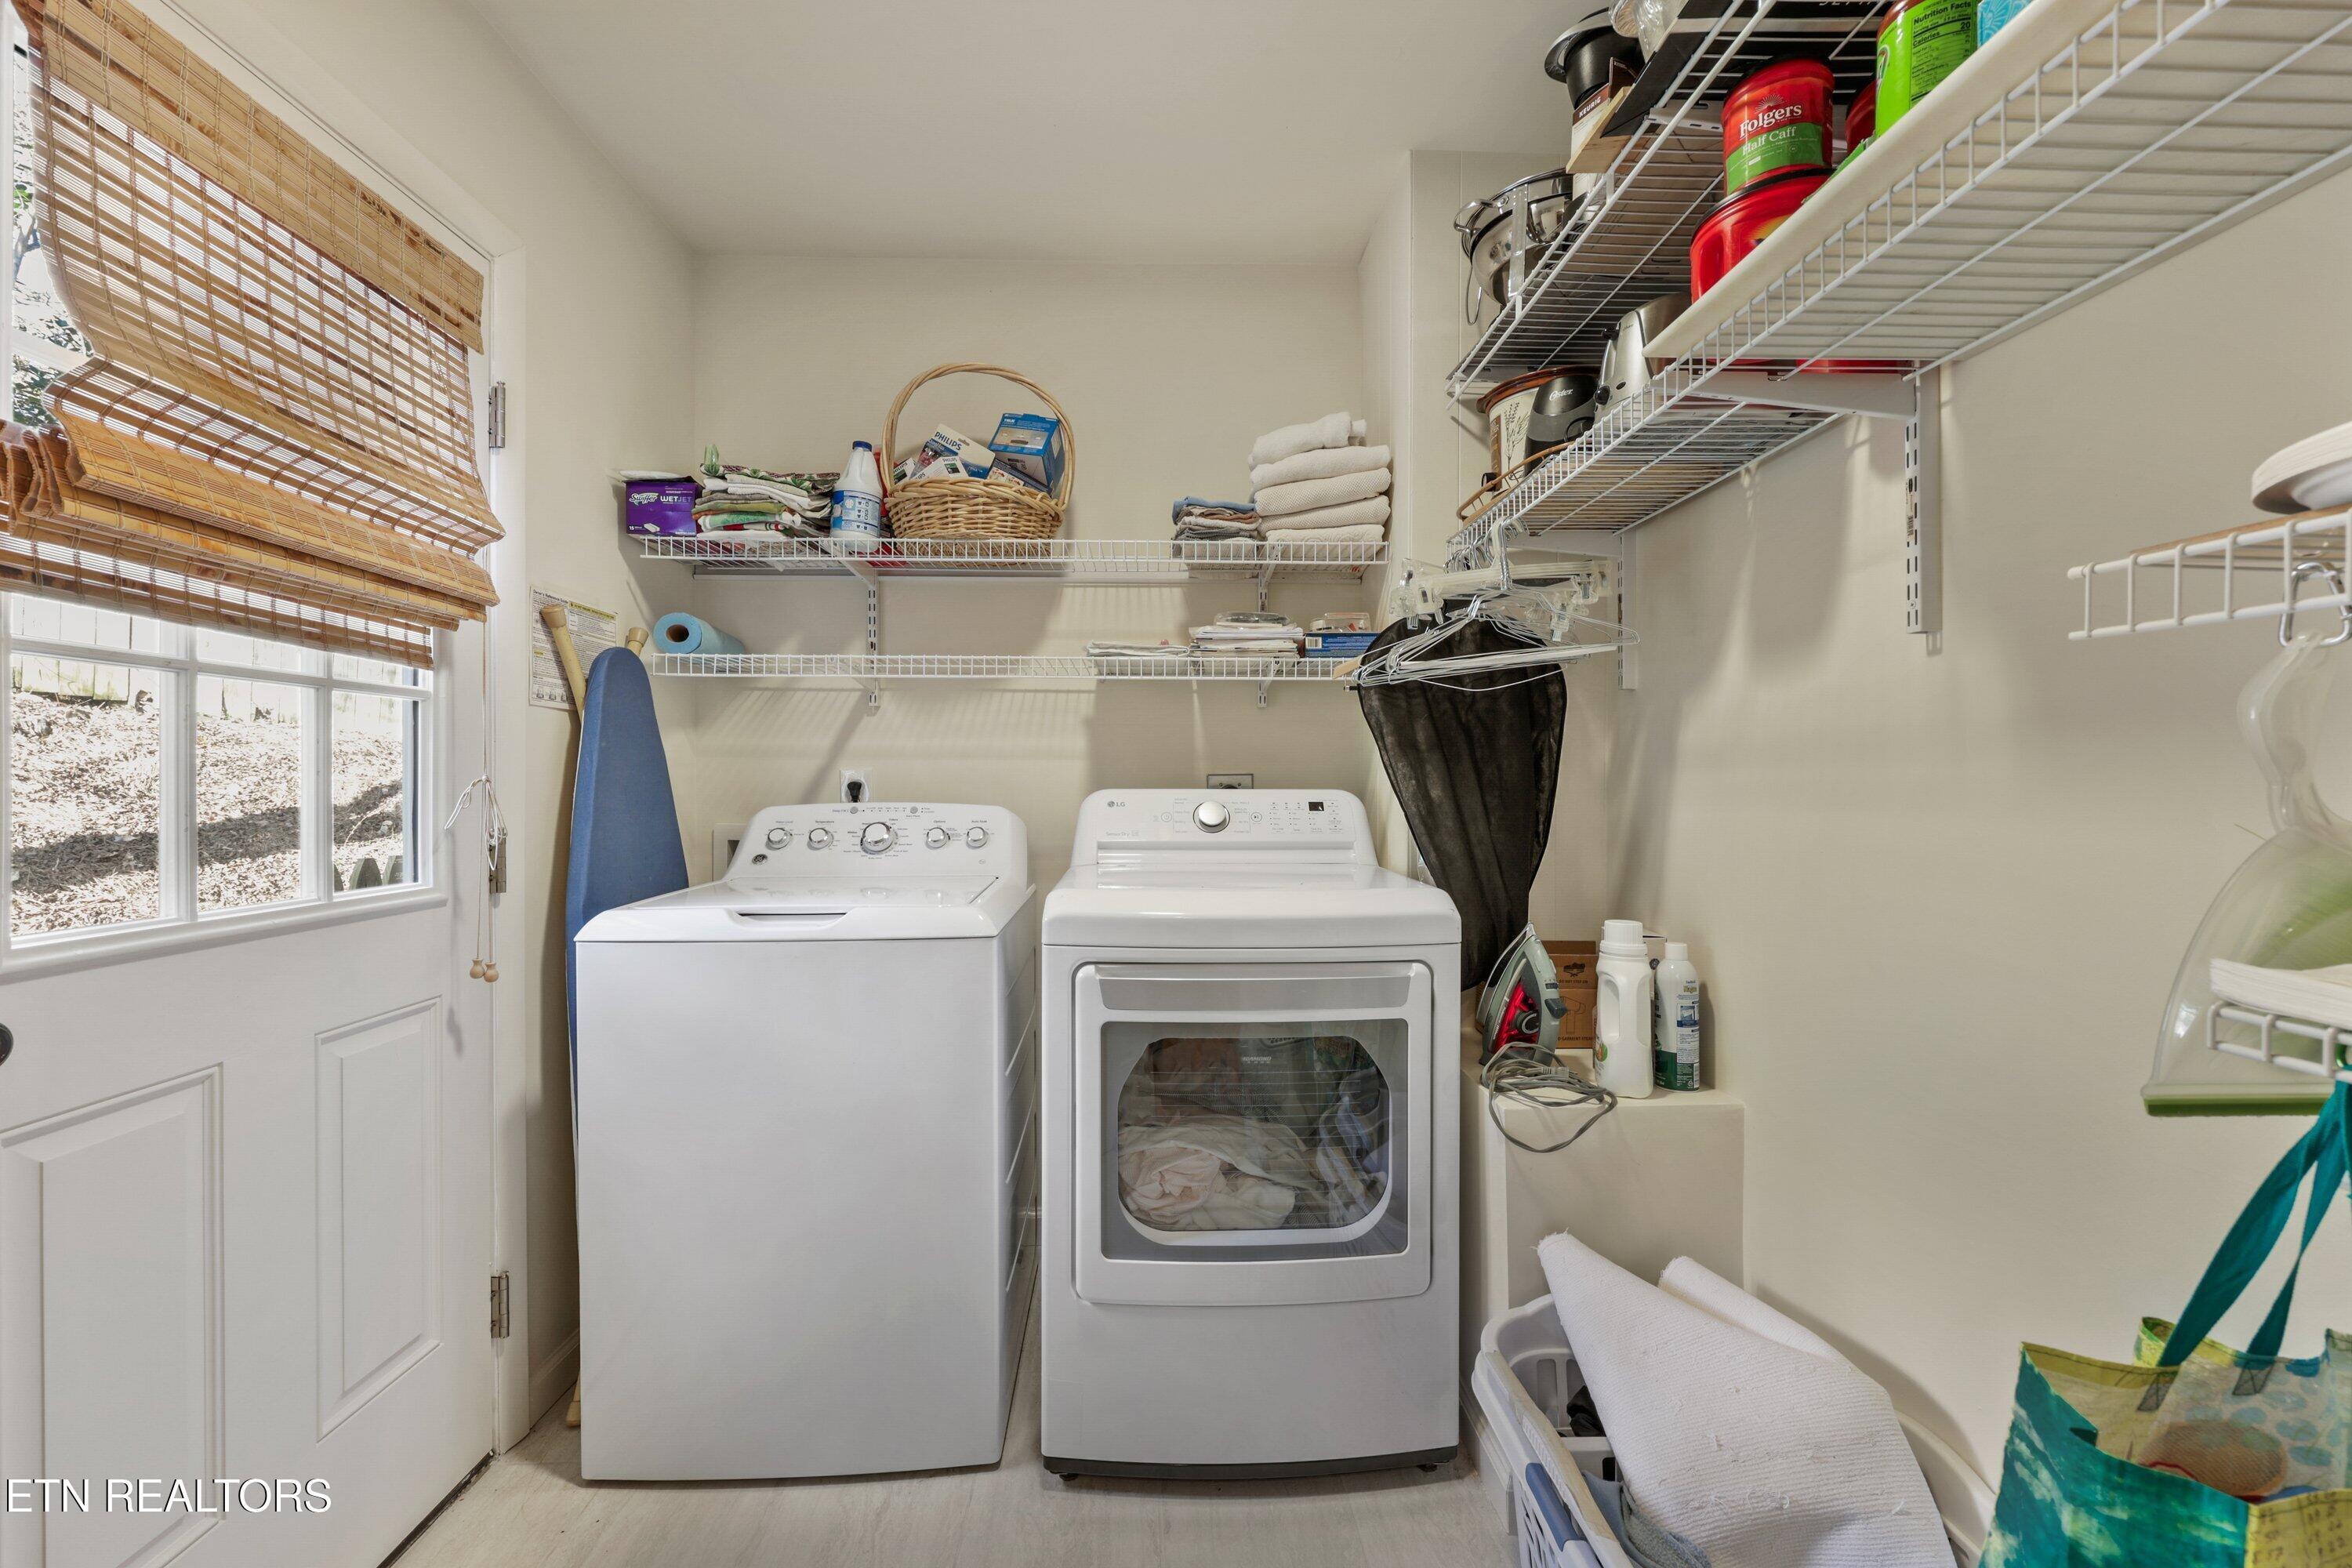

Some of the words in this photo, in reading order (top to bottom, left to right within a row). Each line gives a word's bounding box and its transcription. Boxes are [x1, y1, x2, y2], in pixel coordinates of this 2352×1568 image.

[1914, 5, 1948, 25] Nutrition
[1951, 2, 1971, 10] Facts
[1913, 31, 1940, 46] Calories
[1578, 96, 1602, 118] KEURIG
[1740, 105, 1802, 139] Folgers
[1742, 133, 1766, 156] Half
[1769, 126, 1796, 141] Caff
[1549, 389, 1573, 401] Oster
[935, 431, 962, 451] PHILIPS
[630, 493, 658, 505] Swiffer
